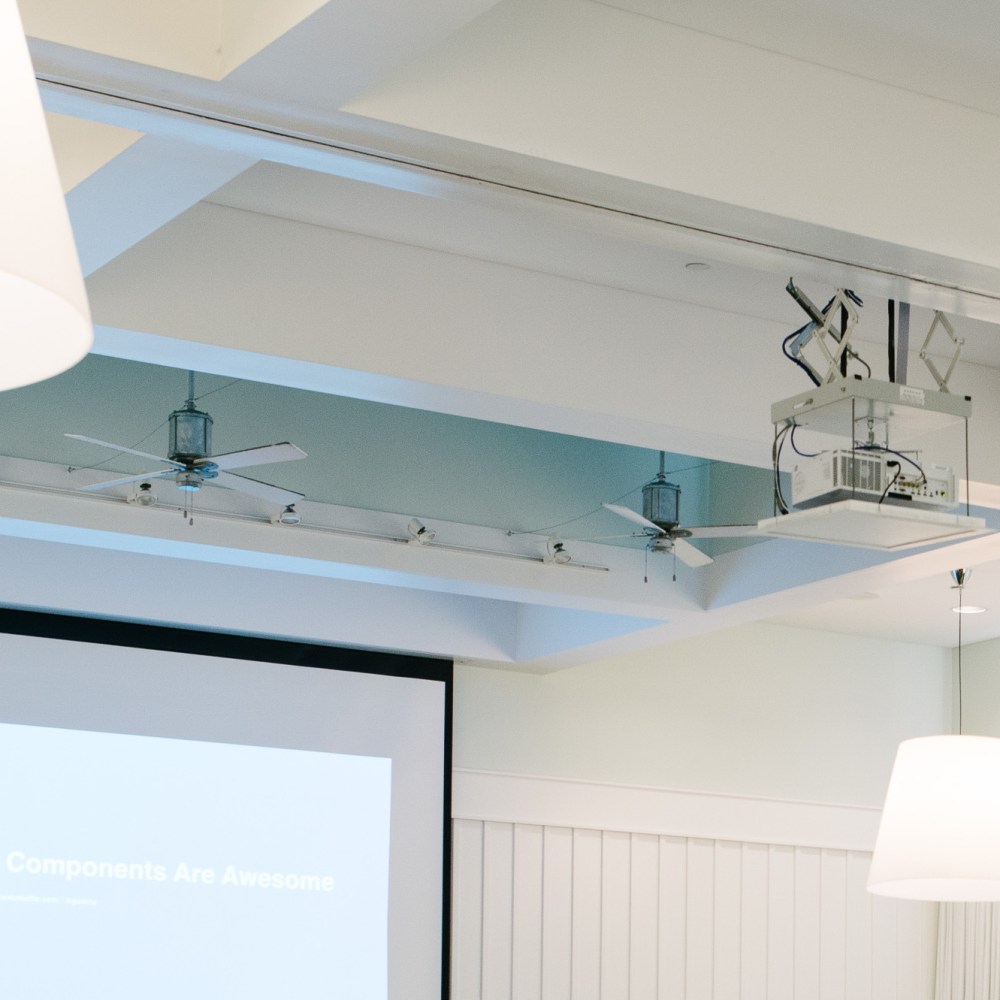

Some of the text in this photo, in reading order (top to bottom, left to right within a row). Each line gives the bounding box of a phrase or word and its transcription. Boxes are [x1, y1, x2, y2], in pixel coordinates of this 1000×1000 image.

[5, 850, 336, 892] Components Are Awesome
